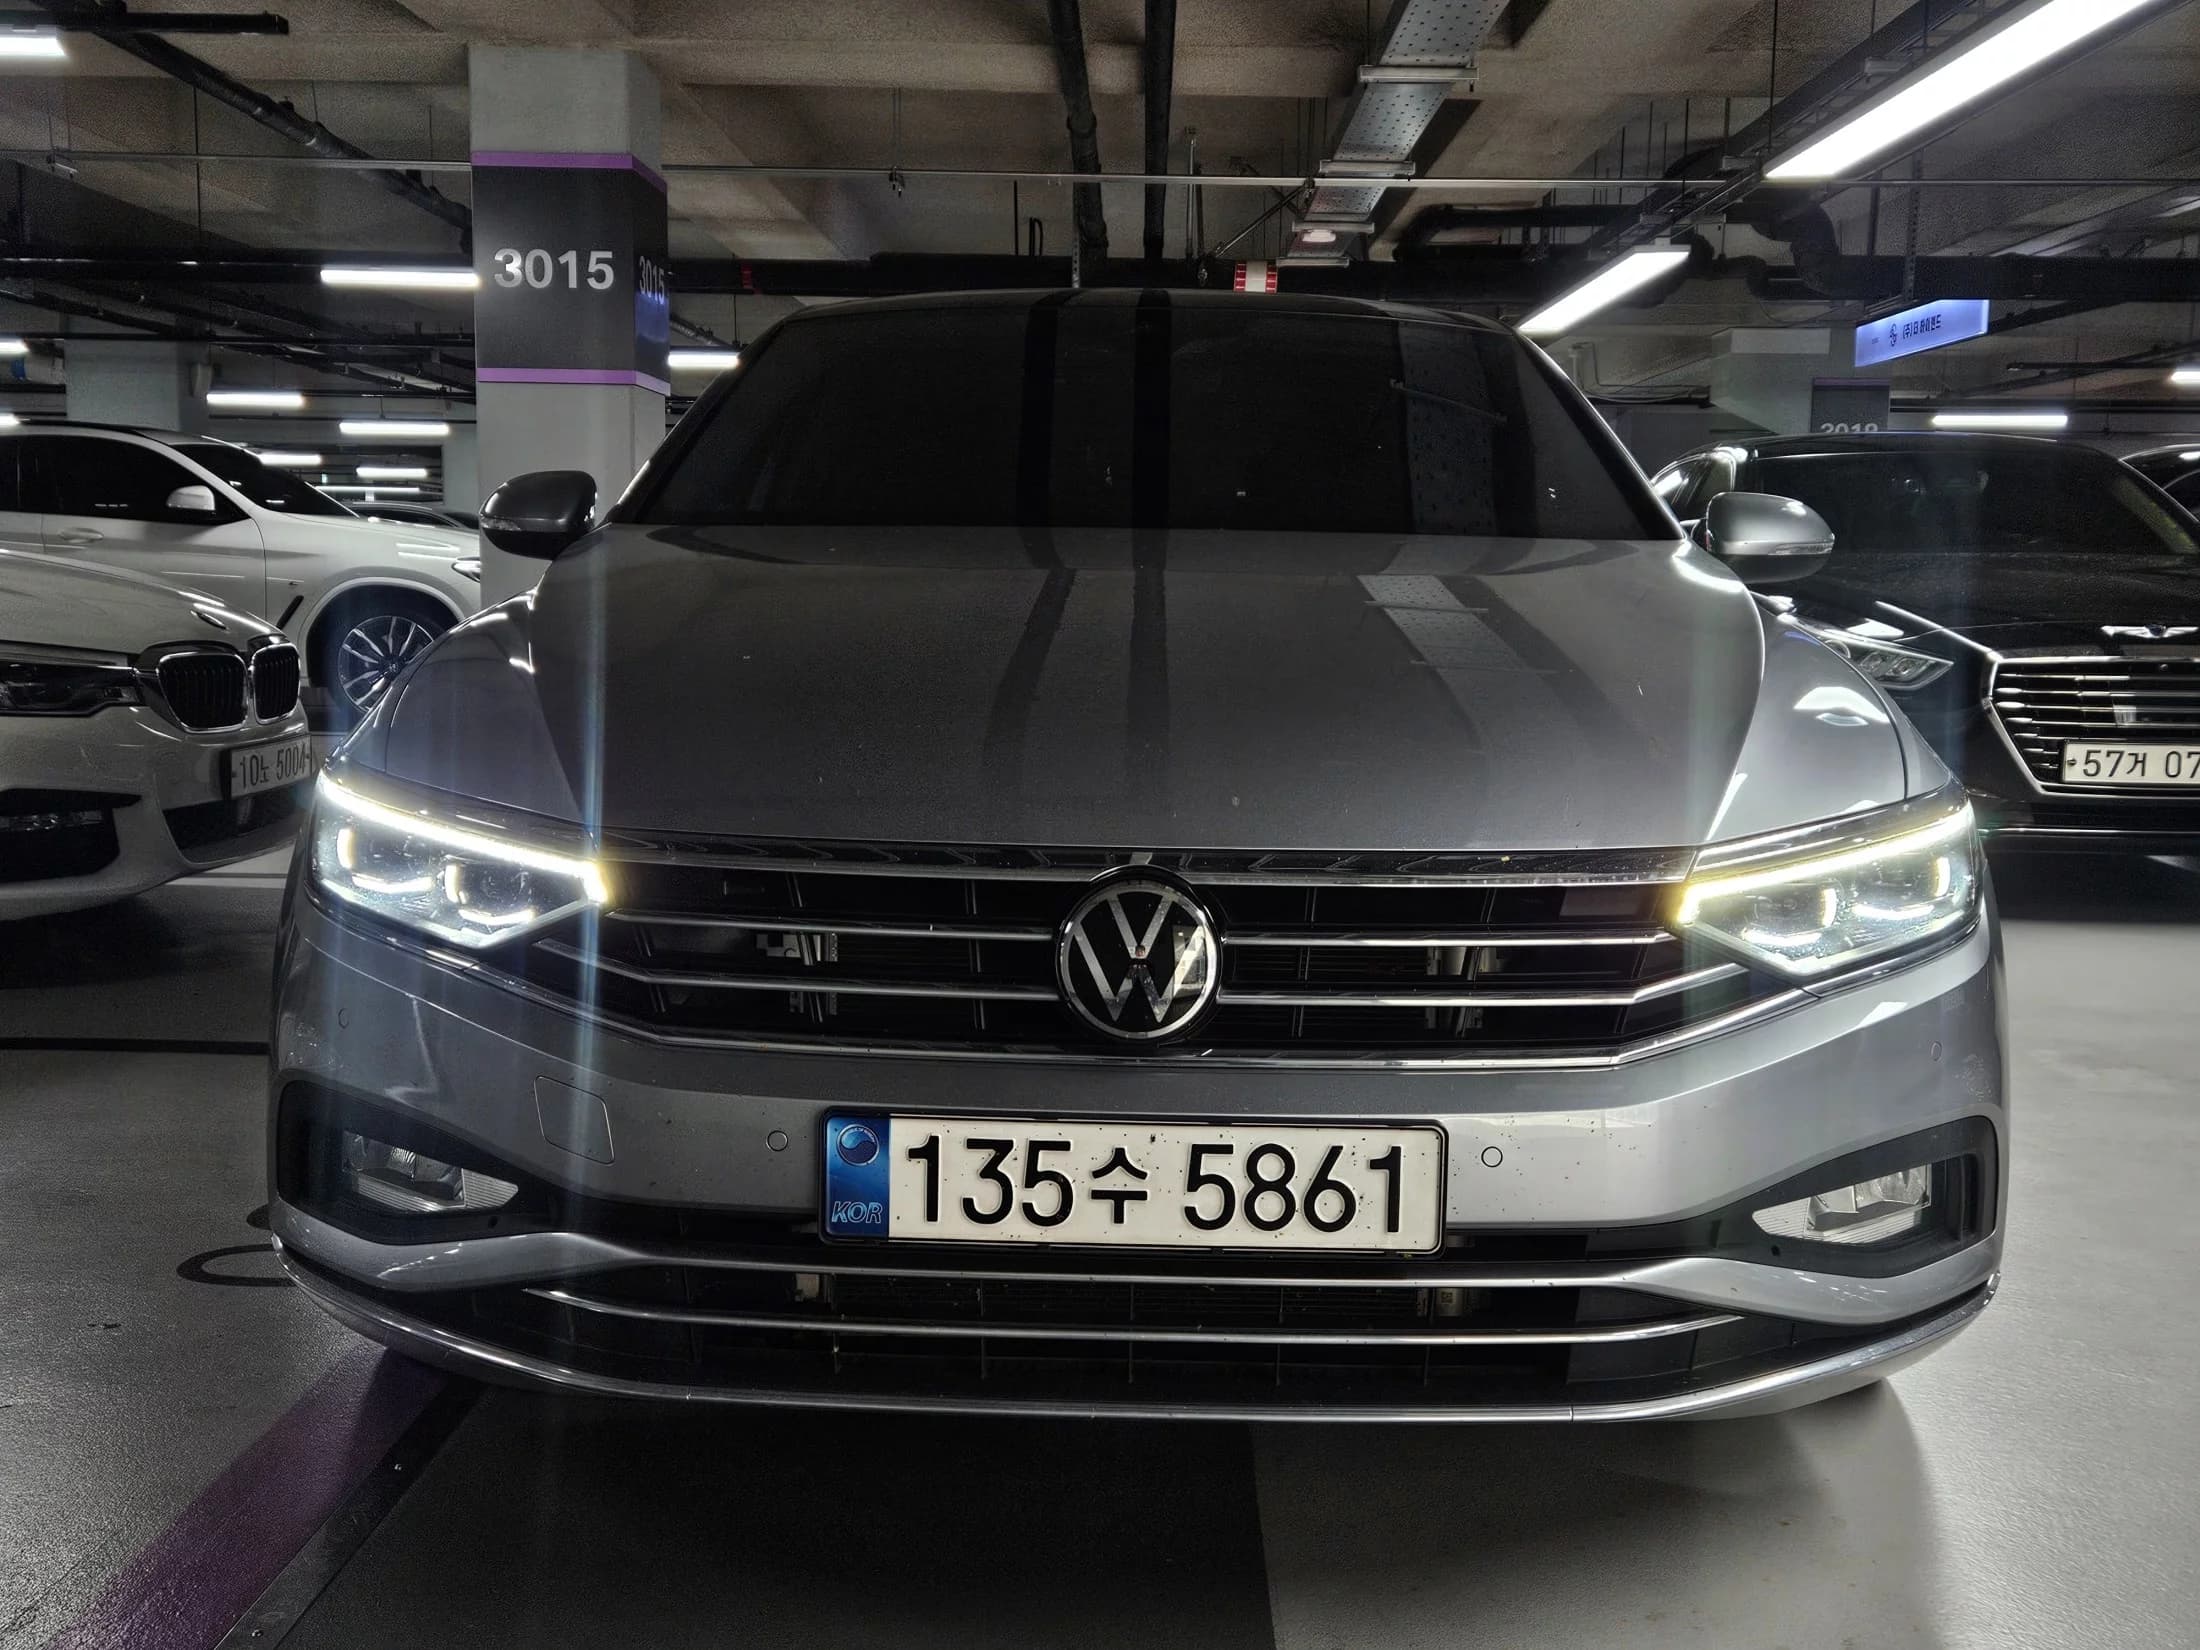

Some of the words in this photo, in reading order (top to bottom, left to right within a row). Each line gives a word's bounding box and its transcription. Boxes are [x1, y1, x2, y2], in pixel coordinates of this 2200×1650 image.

[494, 248, 614, 290] 3015
[639, 255, 665, 305] 3015
[240, 754, 269, 789] 10노
[276, 743, 306, 780] 5004
[2083, 749, 2147, 778] 57거
[2165, 750, 2200, 779] 07
[1064, 882, 1212, 1030] VW
[908, 1134, 1149, 1227] 135수
[1183, 1143, 1402, 1233] 5861
[831, 1201, 883, 1224] KOR
